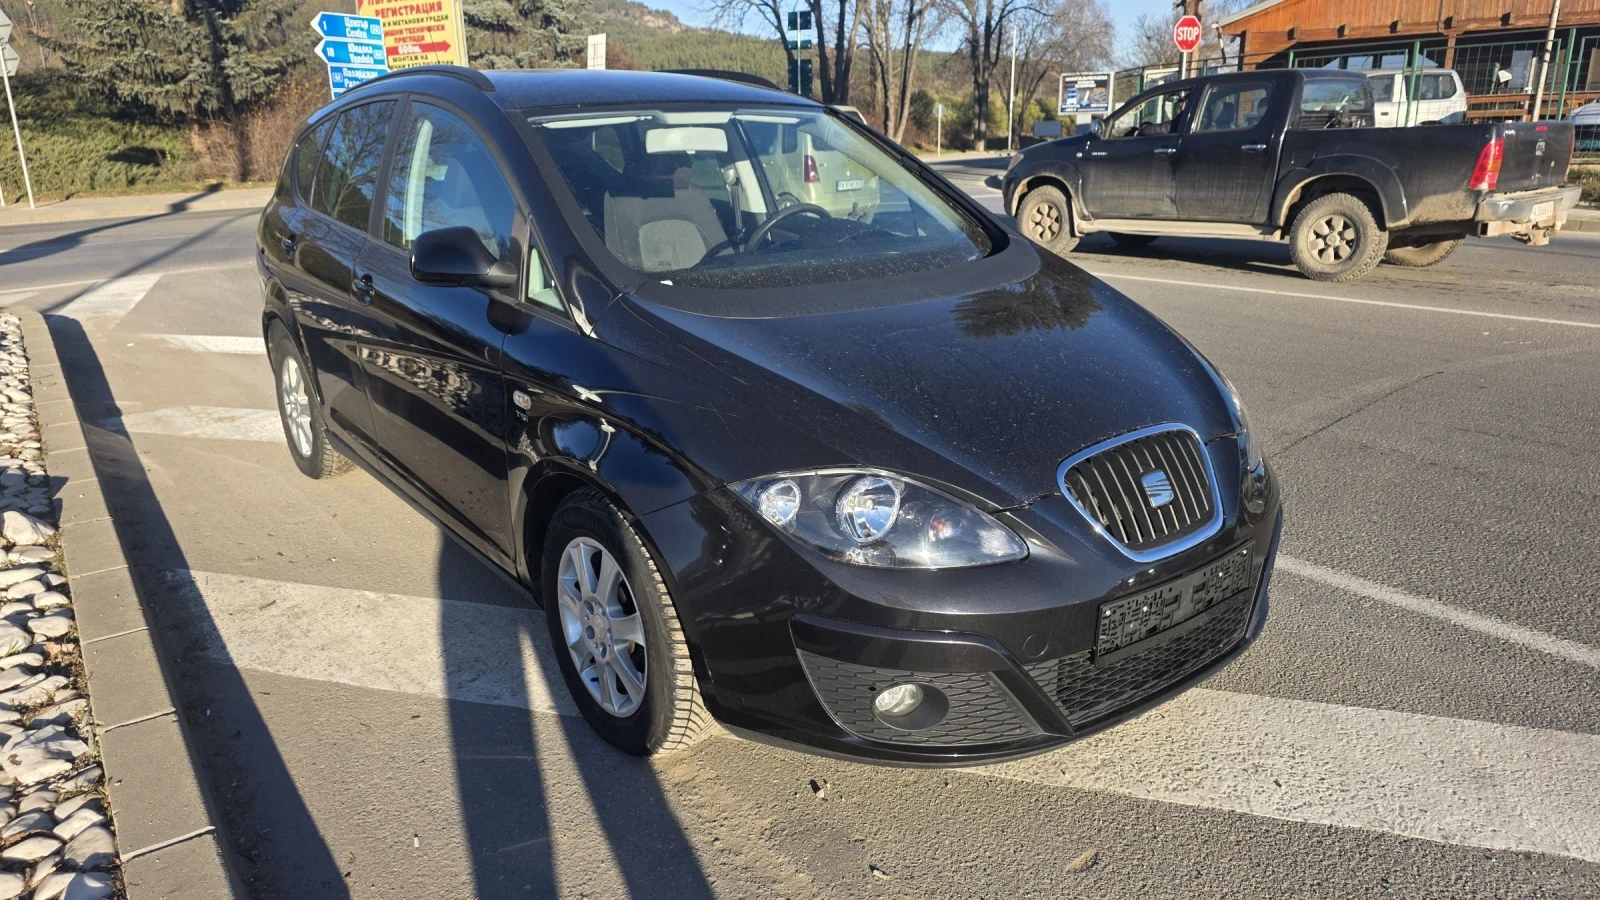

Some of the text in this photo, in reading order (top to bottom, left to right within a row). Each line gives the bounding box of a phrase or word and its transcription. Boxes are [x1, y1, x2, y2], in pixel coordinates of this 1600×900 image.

[374, 1, 442, 18] РЕГИСТРАЦИЯ
[322, 20, 327, 30] 1
[344, 16, 368, 30] Център
[392, 18, 424, 26] МЕТАНОВИ
[426, 14, 449, 22] УРЕДБИ
[1177, 26, 1199, 40] STOP
